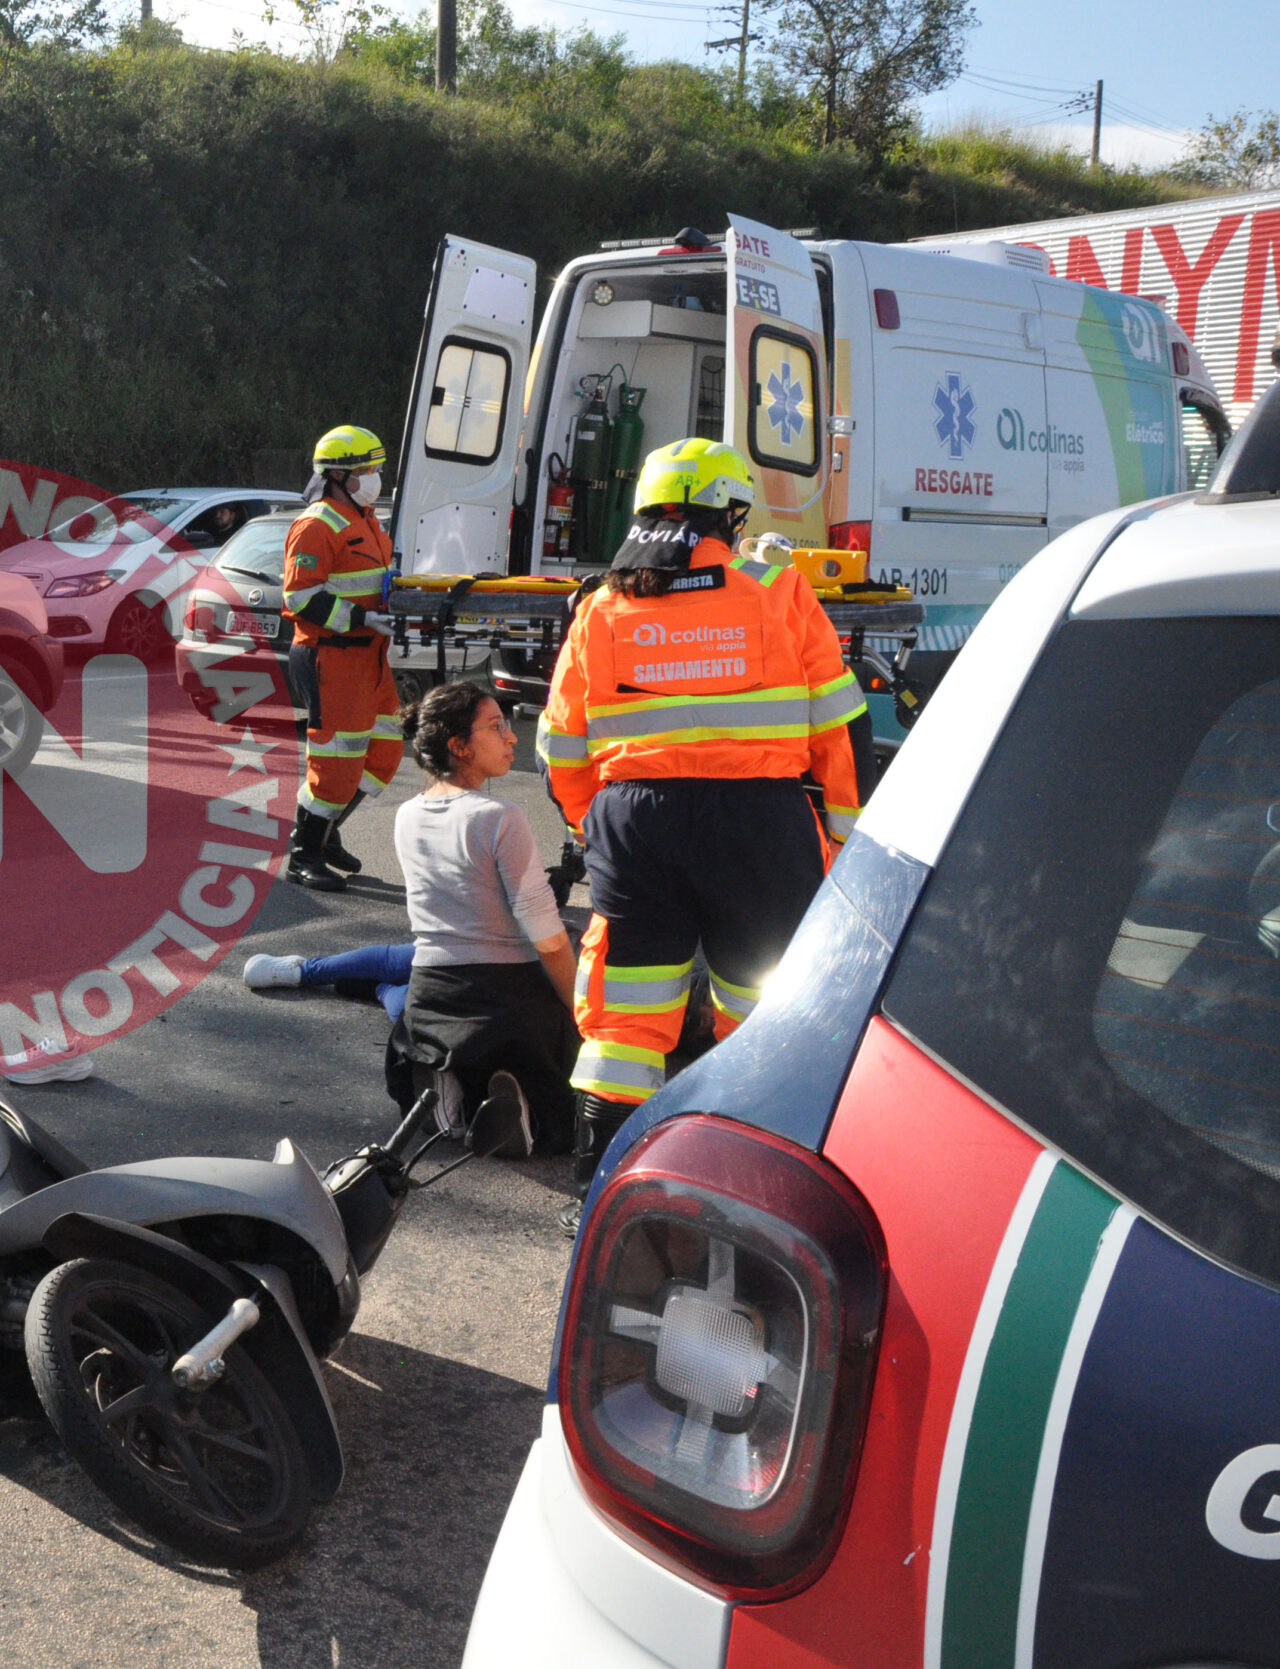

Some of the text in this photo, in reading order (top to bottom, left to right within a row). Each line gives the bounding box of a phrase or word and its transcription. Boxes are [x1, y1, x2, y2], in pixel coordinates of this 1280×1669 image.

[1028, 424, 1085, 455] colinas
[914, 467, 994, 497] RESGATE
[670, 626, 746, 644] colinas
[716, 641, 747, 653] appia
[633, 657, 747, 683] SALVAMENTO
